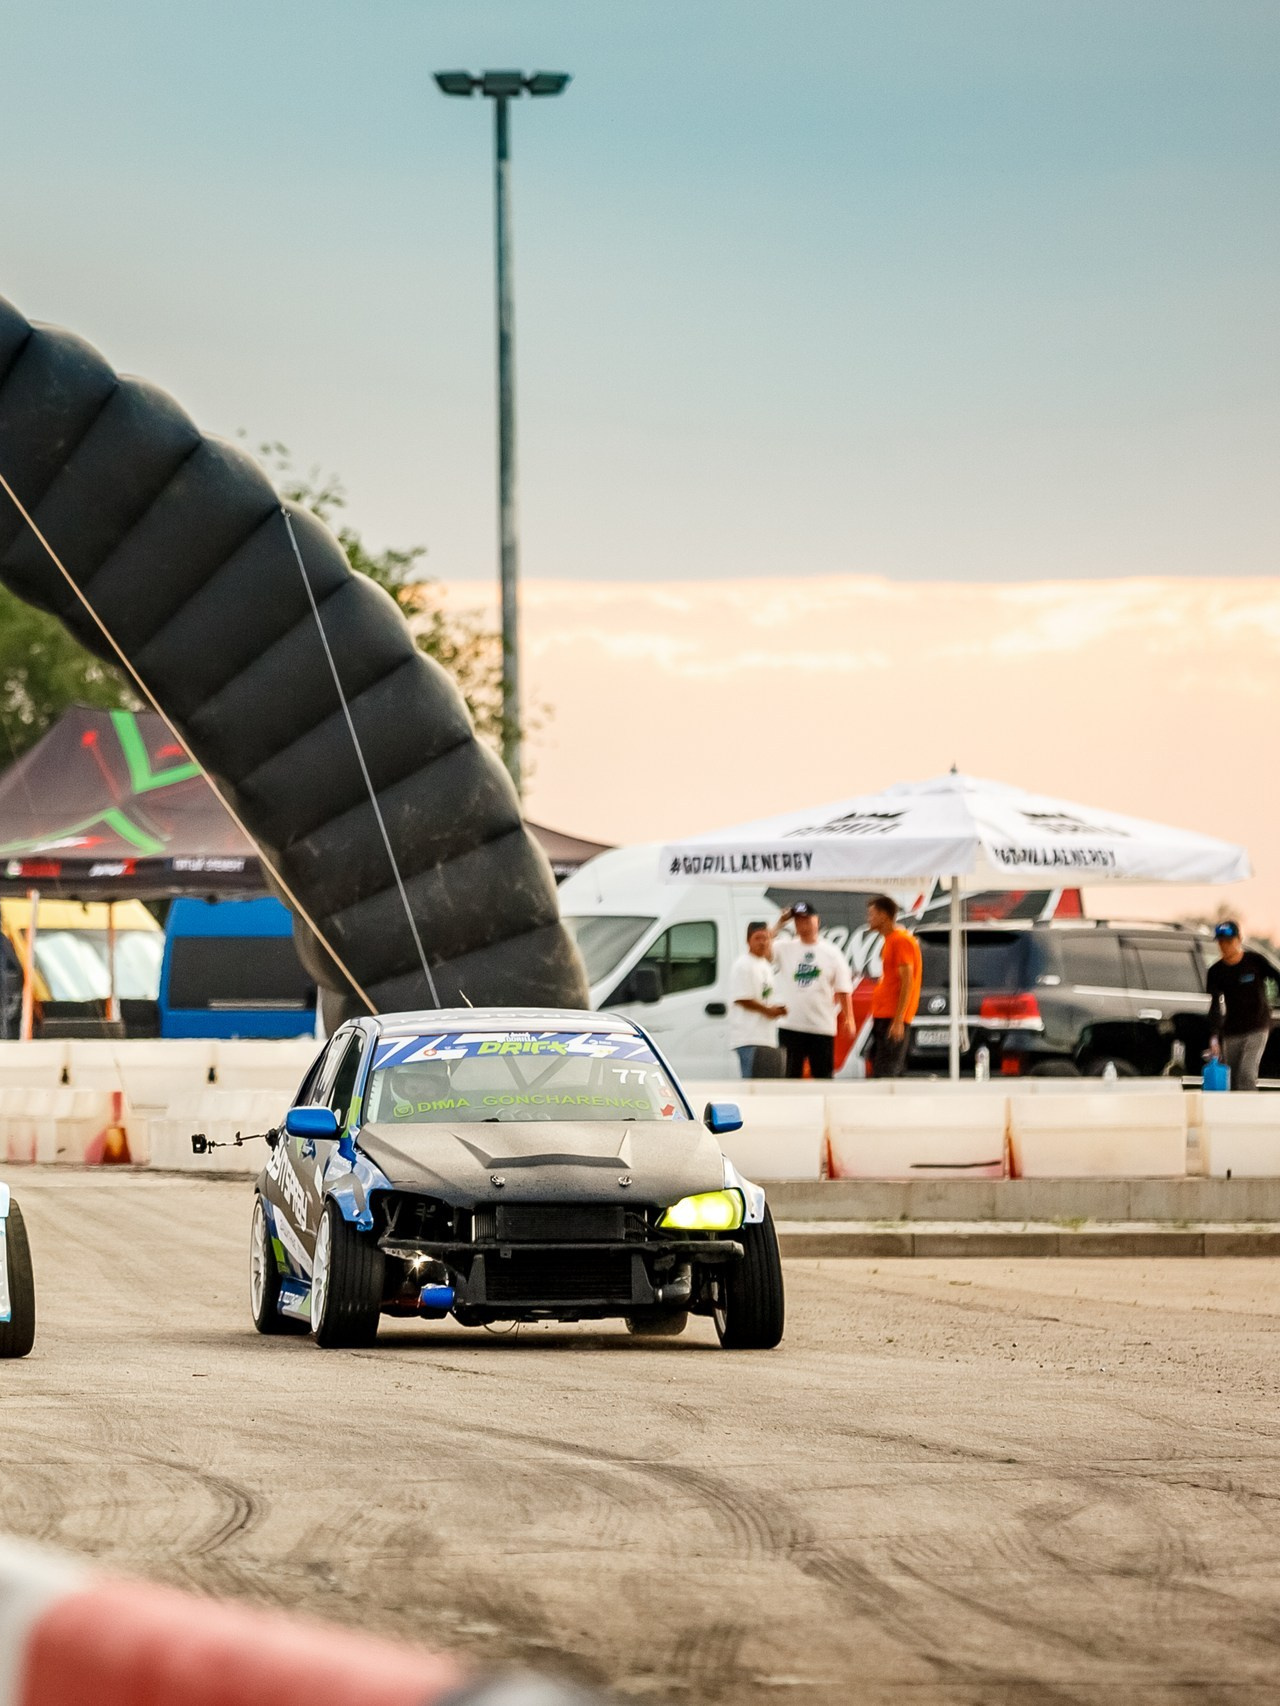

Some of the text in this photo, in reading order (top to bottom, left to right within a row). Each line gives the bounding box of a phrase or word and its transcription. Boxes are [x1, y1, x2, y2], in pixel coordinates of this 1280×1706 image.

[670, 852, 813, 876] #GORILLAENERGY
[477, 1041, 569, 1055] DRIFT
[611, 1067, 665, 1087] 771
